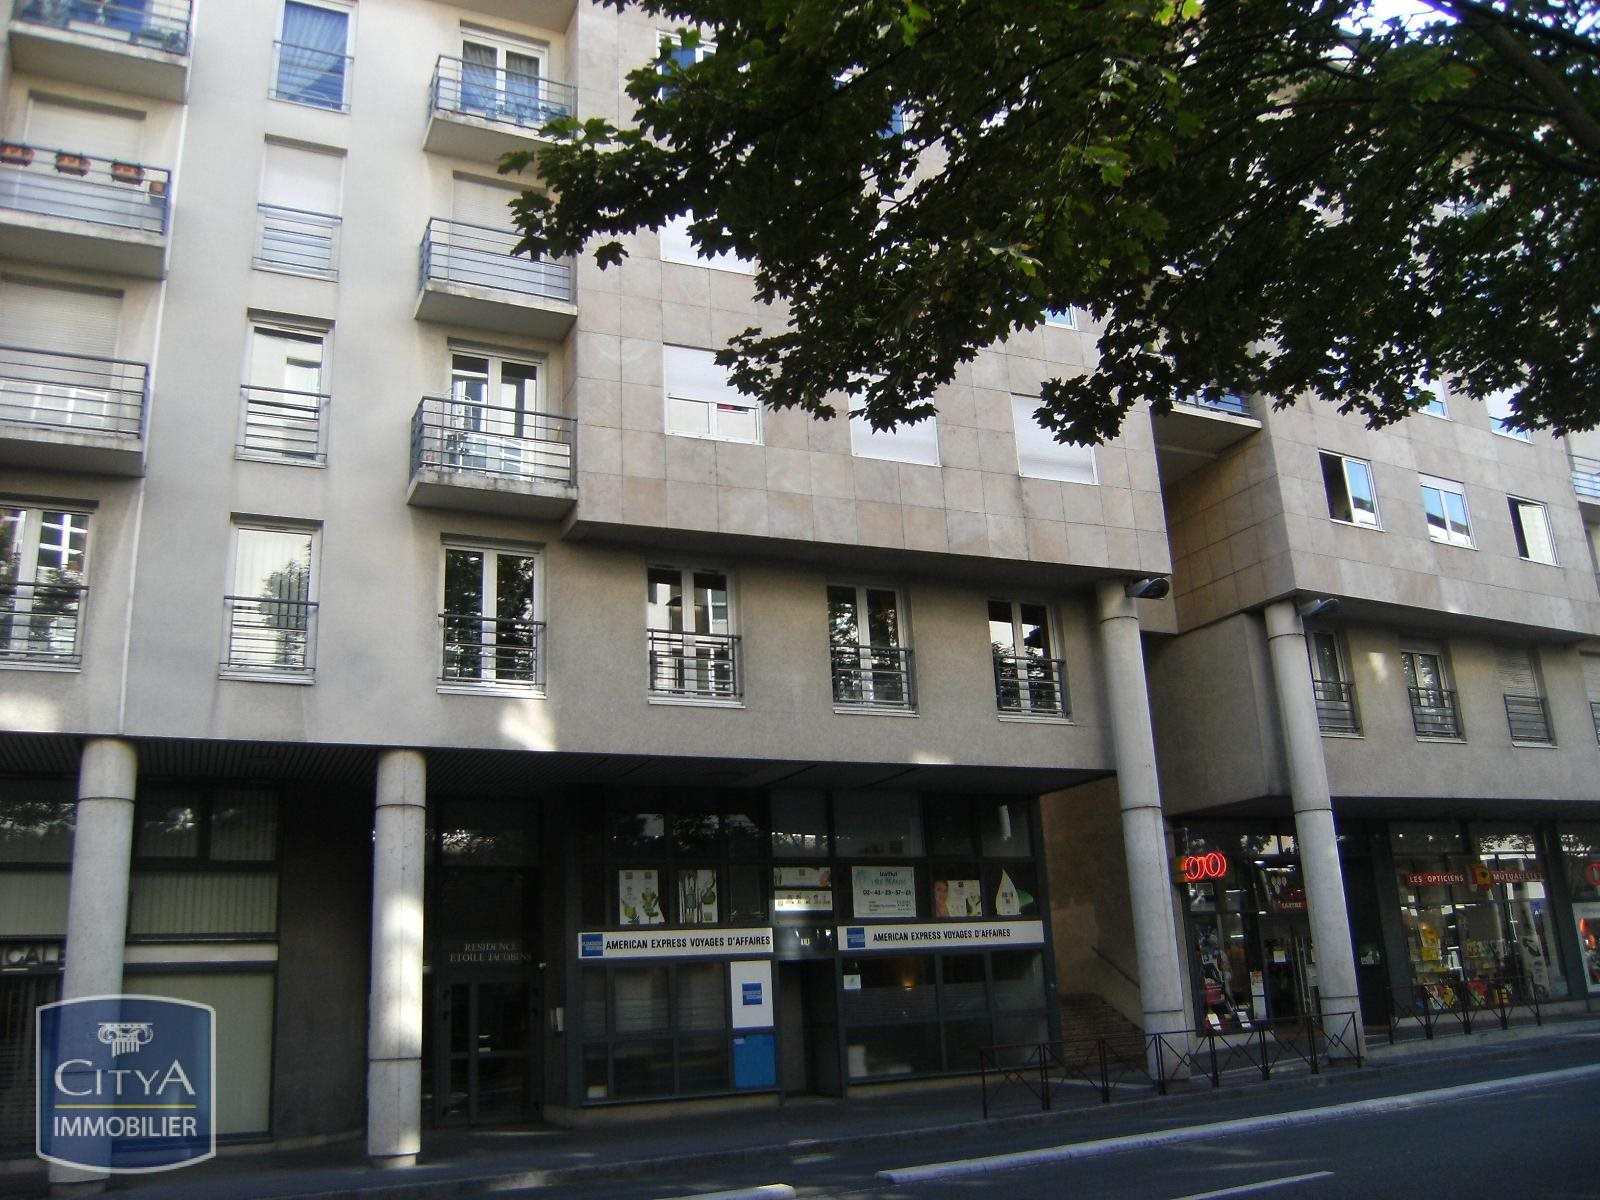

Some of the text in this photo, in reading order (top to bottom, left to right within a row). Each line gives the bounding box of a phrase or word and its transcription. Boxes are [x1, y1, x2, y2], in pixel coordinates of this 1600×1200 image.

[1409, 875, 1422, 883] LES
[1427, 874, 1465, 883] OPTICIENS
[873, 932, 909, 942] AMERICAN
[911, 931, 941, 941] EXPRESS
[943, 929, 972, 940] VOYAGES
[974, 928, 1011, 938] D'AFFAIRES
[605, 939, 648, 951] AMERICAN
[651, 938, 687, 949] EXPRESS
[690, 937, 724, 948] VOYAGES
[727, 936, 771, 946] D'AFFAIRES
